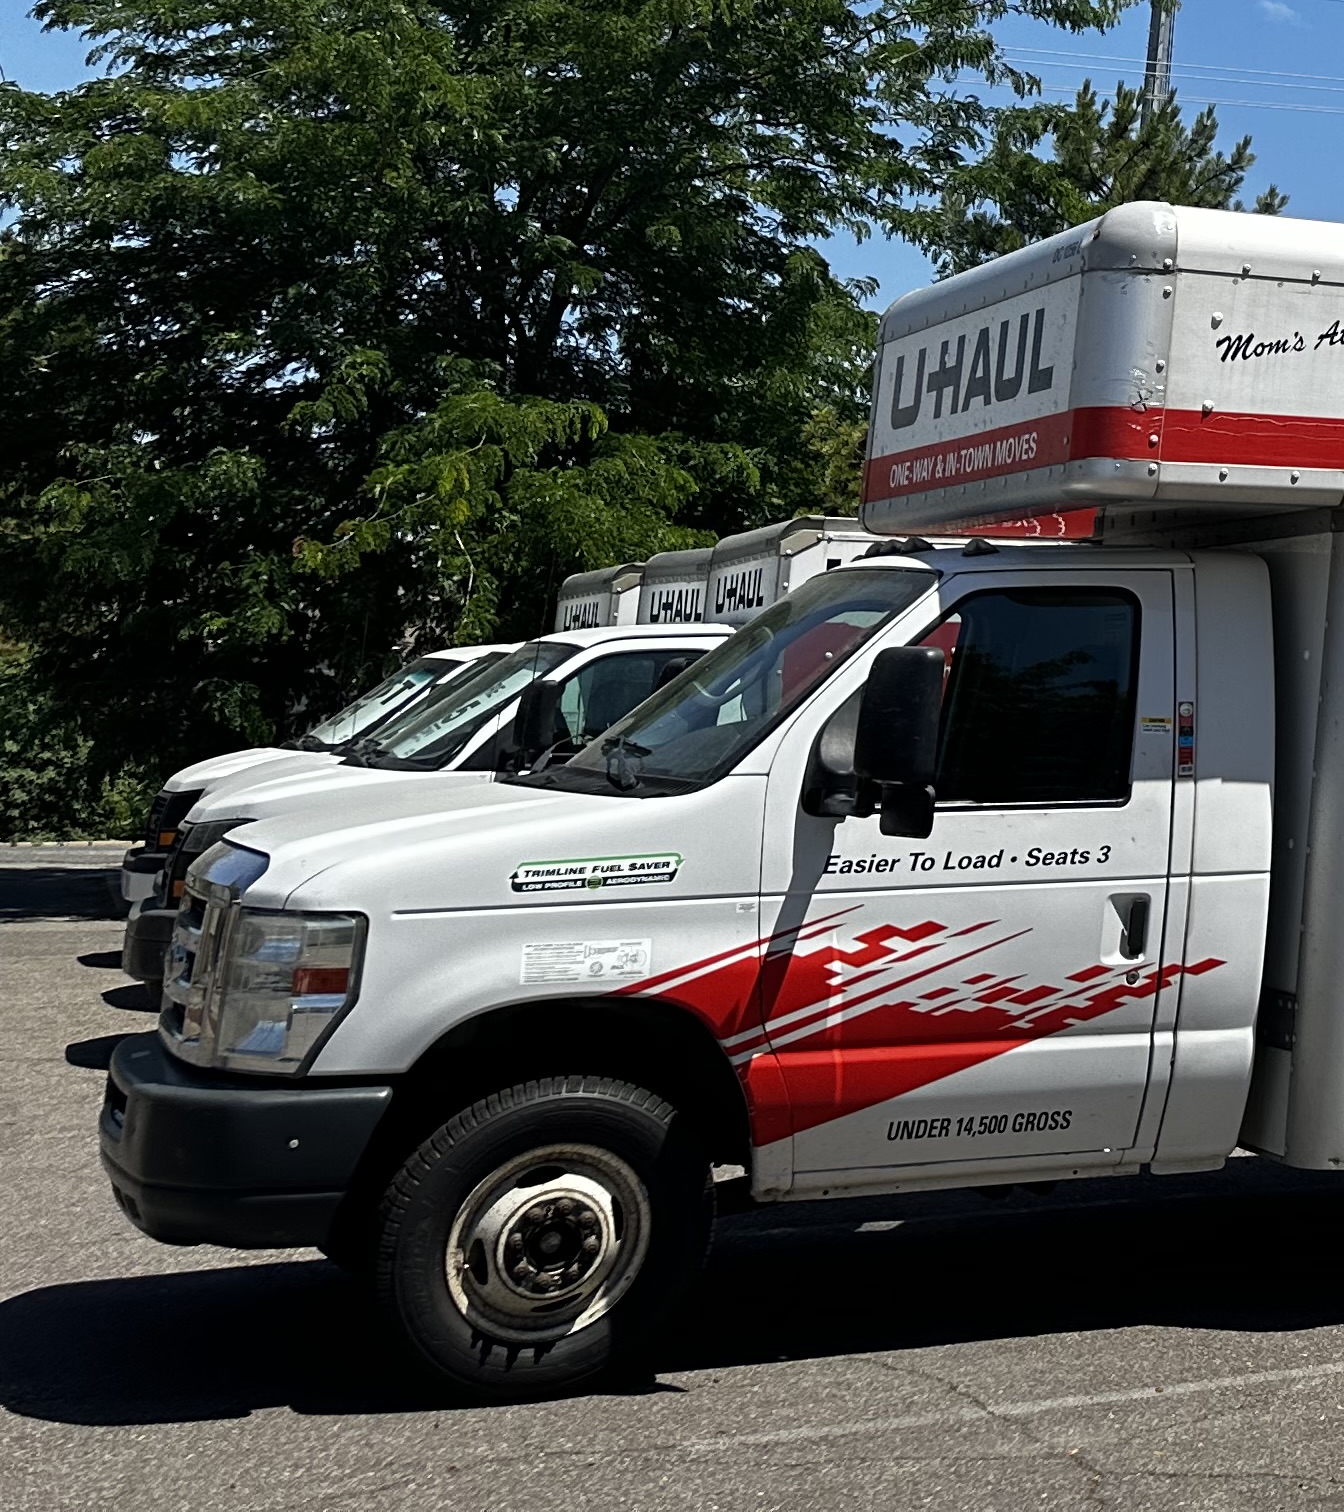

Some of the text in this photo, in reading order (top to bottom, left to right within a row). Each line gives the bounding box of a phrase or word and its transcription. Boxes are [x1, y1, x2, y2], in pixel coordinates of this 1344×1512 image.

[1215, 331, 1307, 362] Mom's
[890, 307, 1055, 431] U-HAUL
[889, 431, 1038, 488] ONE-WAY & IN-TOWN MOVES
[523, 866, 587, 878] TRIMLINE
[591, 864, 625, 874] FUEL
[822, 845, 1112, 875] Easier To Load Seats 3
[886, 1110, 1073, 1141] UNDER 14,500 GROSS
